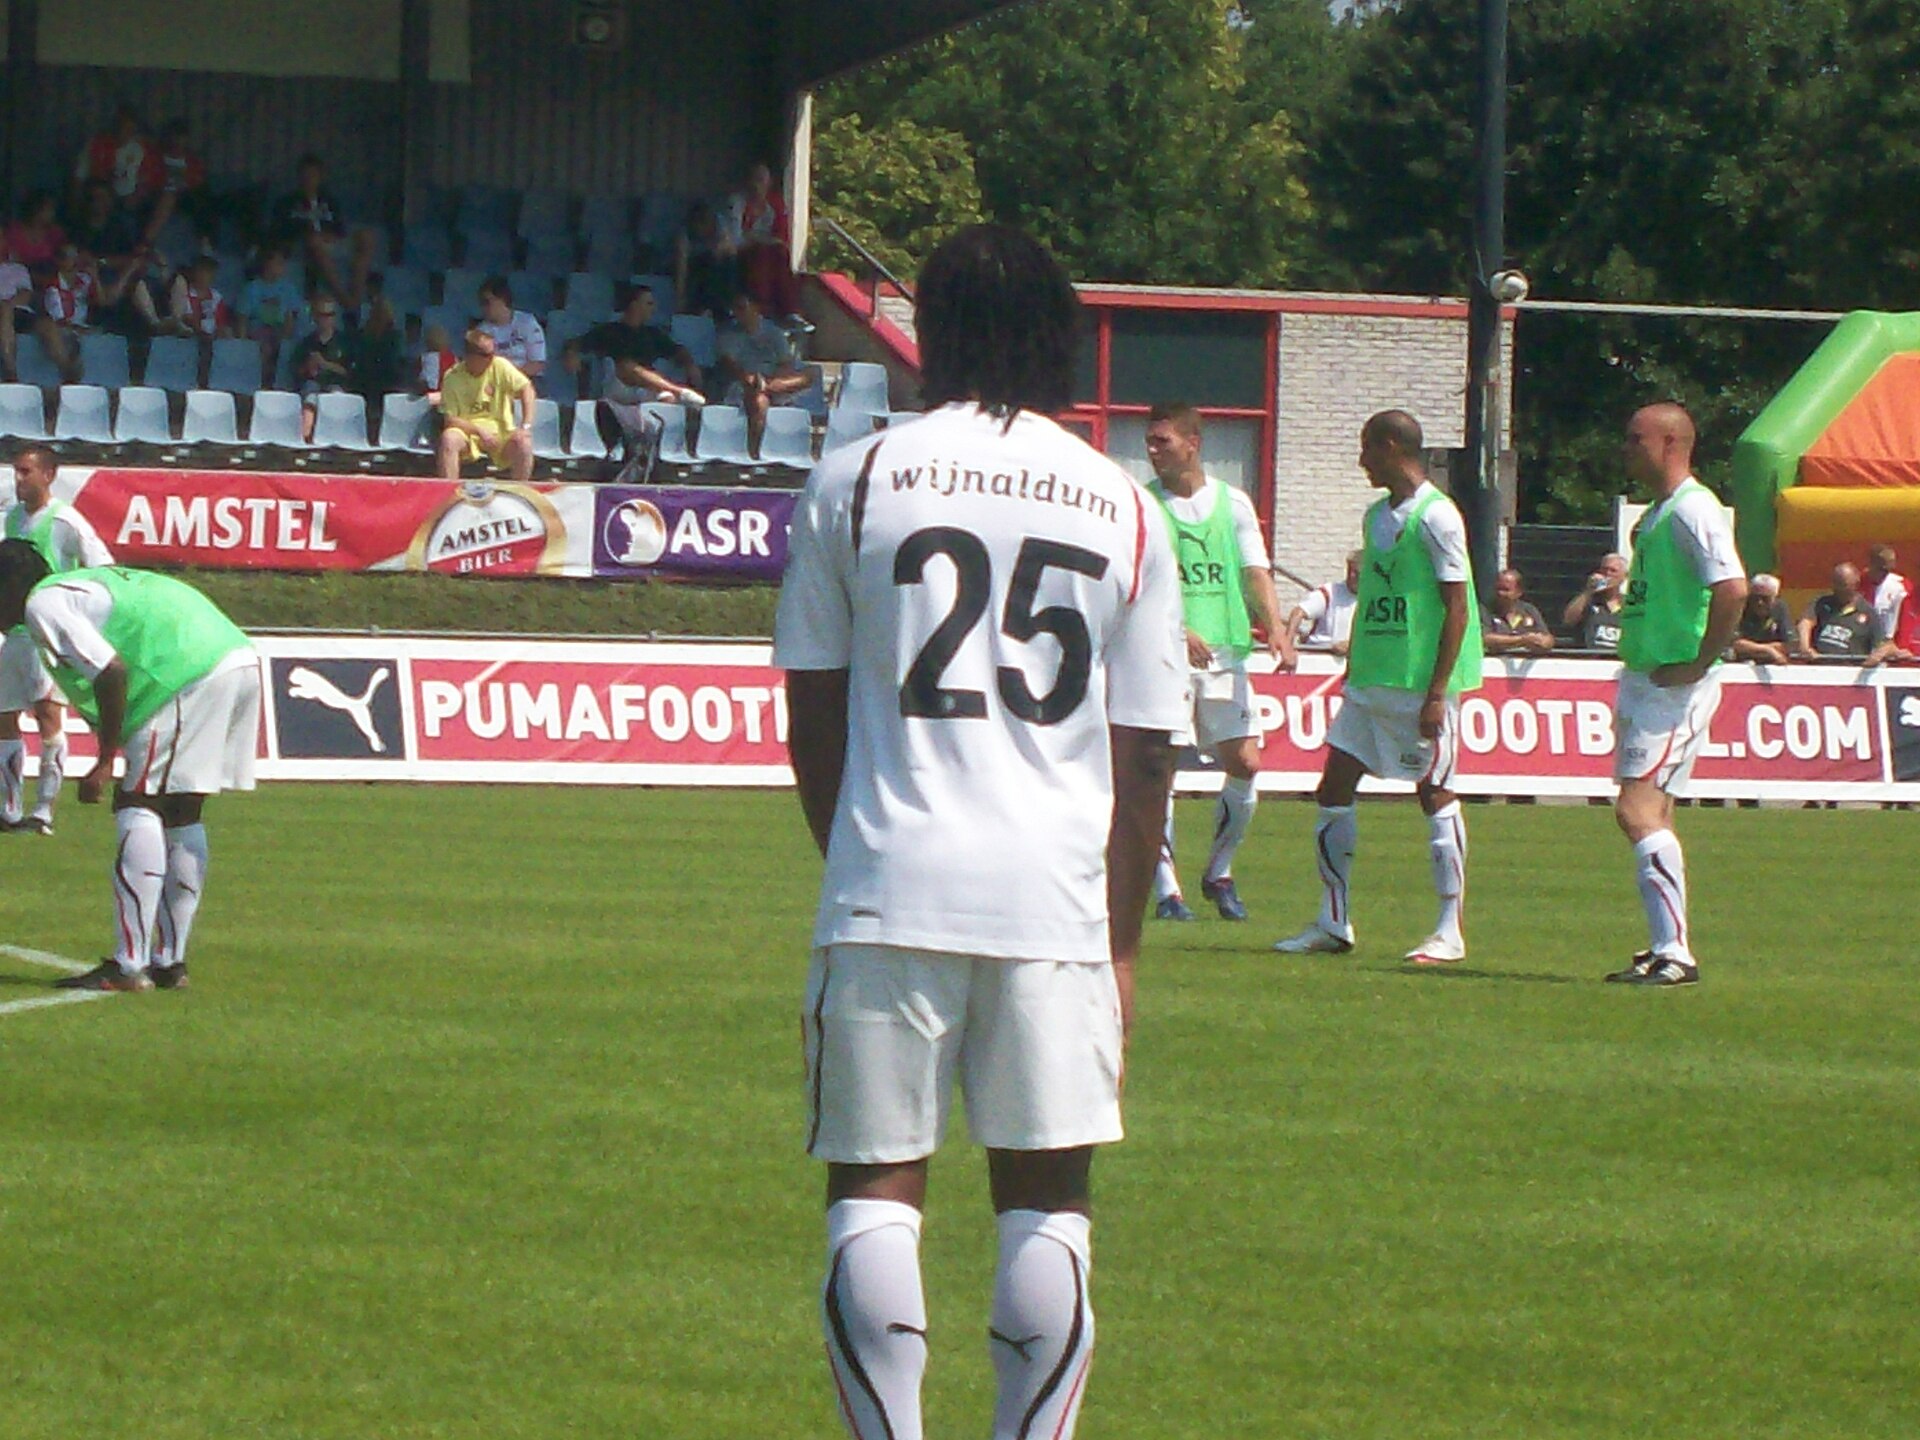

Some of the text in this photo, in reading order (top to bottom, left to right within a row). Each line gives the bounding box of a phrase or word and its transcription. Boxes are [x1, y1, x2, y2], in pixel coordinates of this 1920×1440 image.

[890, 458, 1118, 523] wijnaldum
[117, 495, 337, 551] AMSTEL
[440, 516, 532, 553] AMSTEL
[670, 508, 771, 556] ASR
[457, 548, 513, 573] BIER
[894, 526, 1109, 726] 25
[1364, 596, 1407, 624] ASR
